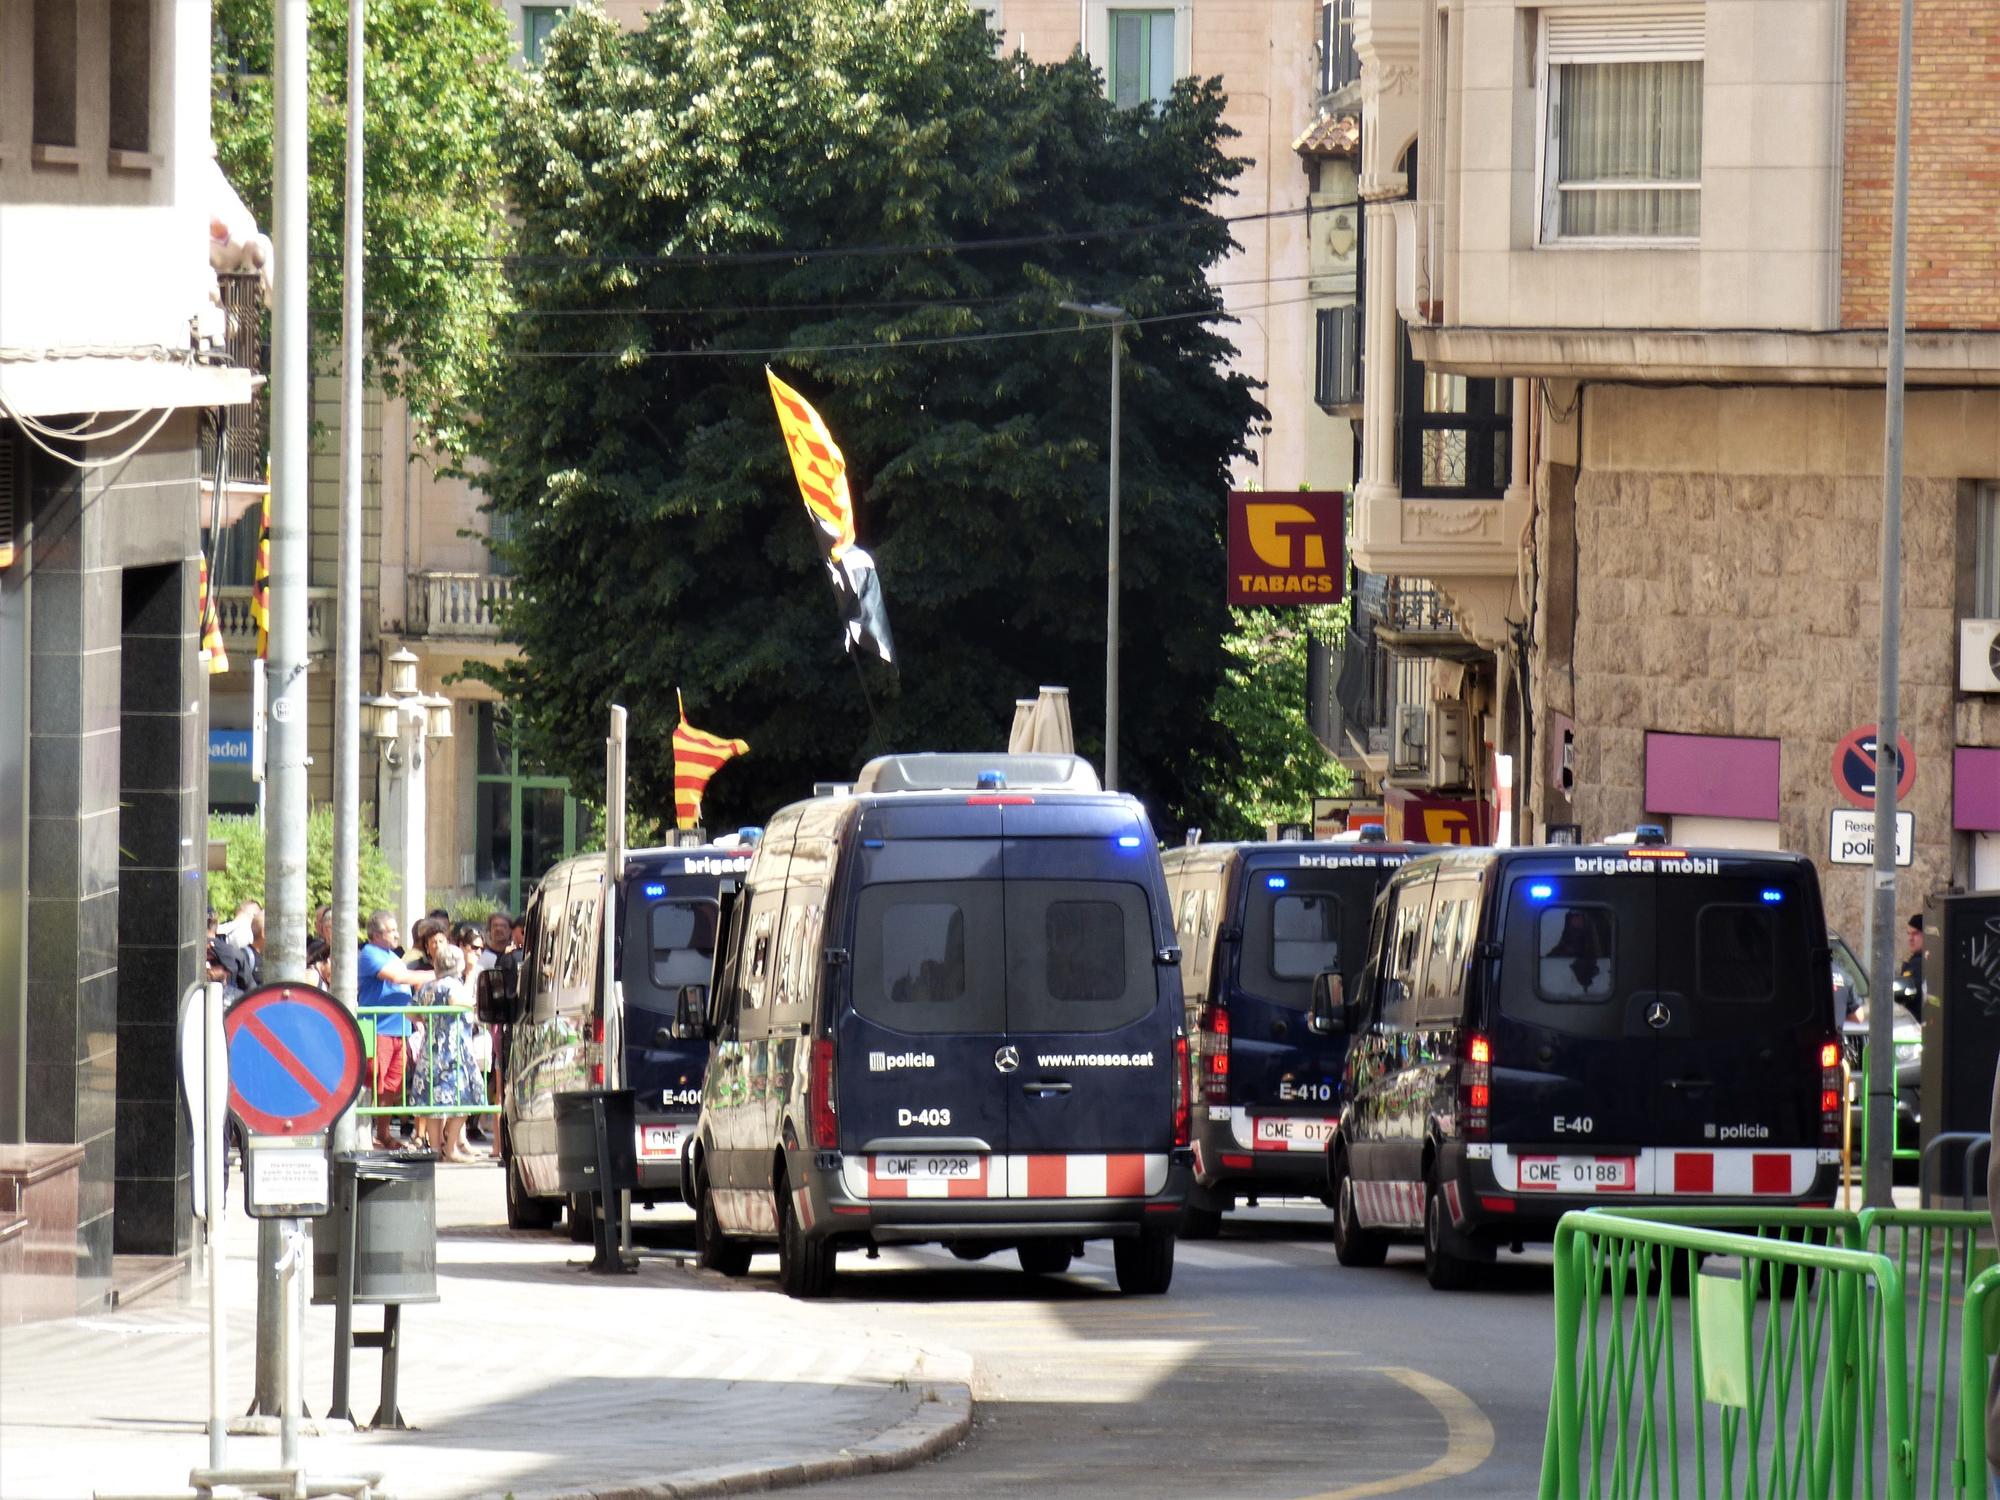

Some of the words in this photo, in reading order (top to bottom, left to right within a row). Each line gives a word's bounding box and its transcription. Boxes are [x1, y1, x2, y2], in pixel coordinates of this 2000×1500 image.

[1238, 574, 1333, 593] TABACS
[1844, 820, 1899, 833] Rese
[1842, 838, 1901, 858] poli
[1299, 854, 1376, 869] brigada
[1574, 857, 1655, 875] brigada
[1661, 857, 1719, 875] mòbil
[886, 1052, 935, 1070] policia
[1037, 1051, 1154, 1067] www.mossos.cat
[1280, 1083, 1331, 1101] E-410
[898, 1109, 951, 1126] D-403
[1553, 1116, 1594, 1132] E-40
[1265, 1123, 1294, 1139] CME
[1304, 1124, 1334, 1140] 017
[1720, 1123, 1769, 1141] policia
[887, 1159, 917, 1175] CME
[928, 1159, 968, 1175] 0228
[1529, 1164, 1561, 1181] CME
[1573, 1164, 1617, 1181] 0188
